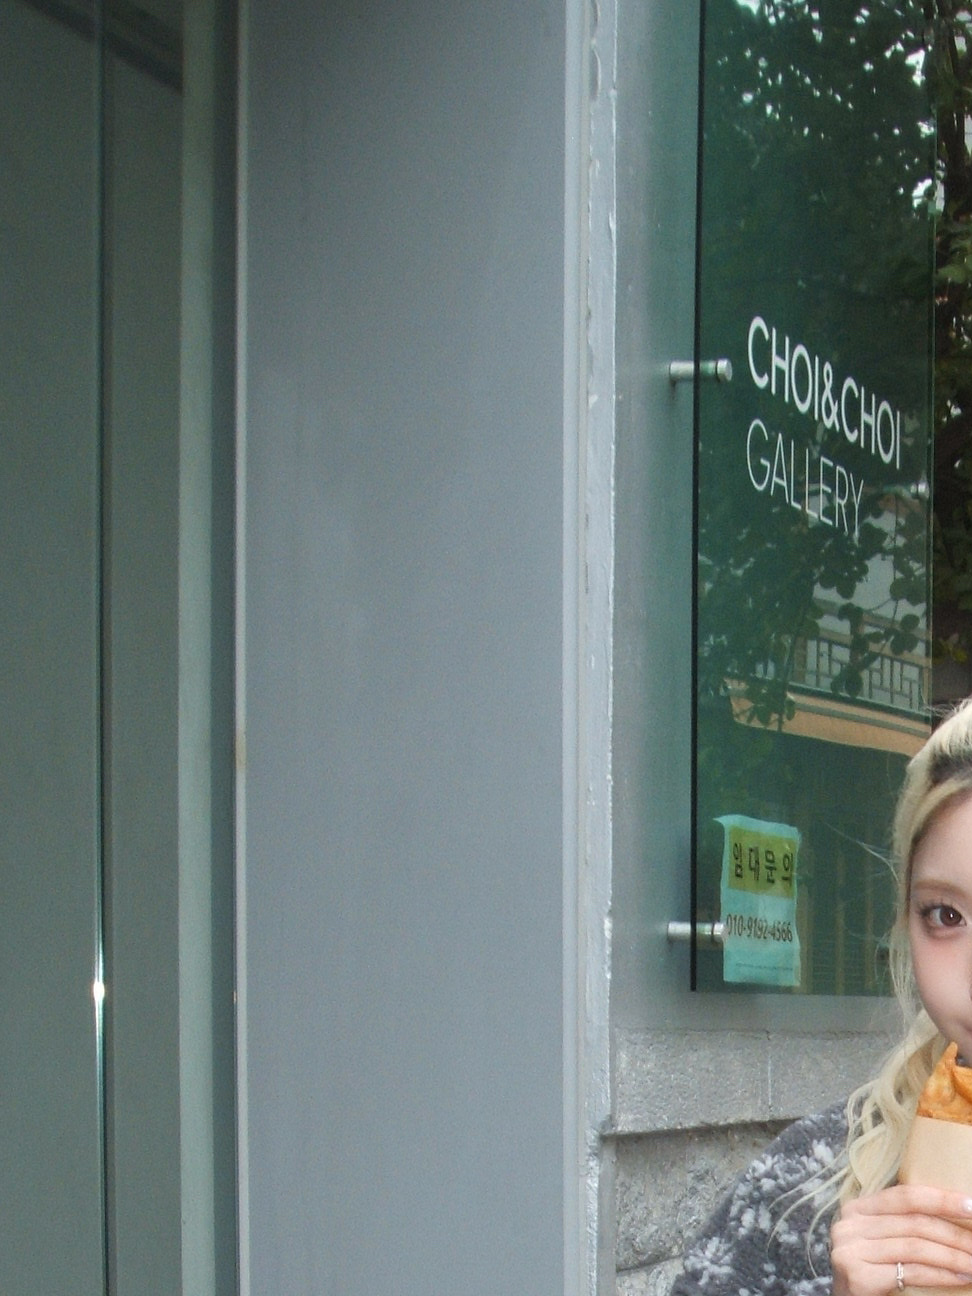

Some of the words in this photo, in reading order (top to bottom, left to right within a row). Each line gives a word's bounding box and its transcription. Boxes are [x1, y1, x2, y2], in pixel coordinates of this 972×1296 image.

[748, 316, 900, 469] CHOI&CHOI
[747, 419, 864, 541] GALLERY
[733, 842, 793, 888] 임대문의
